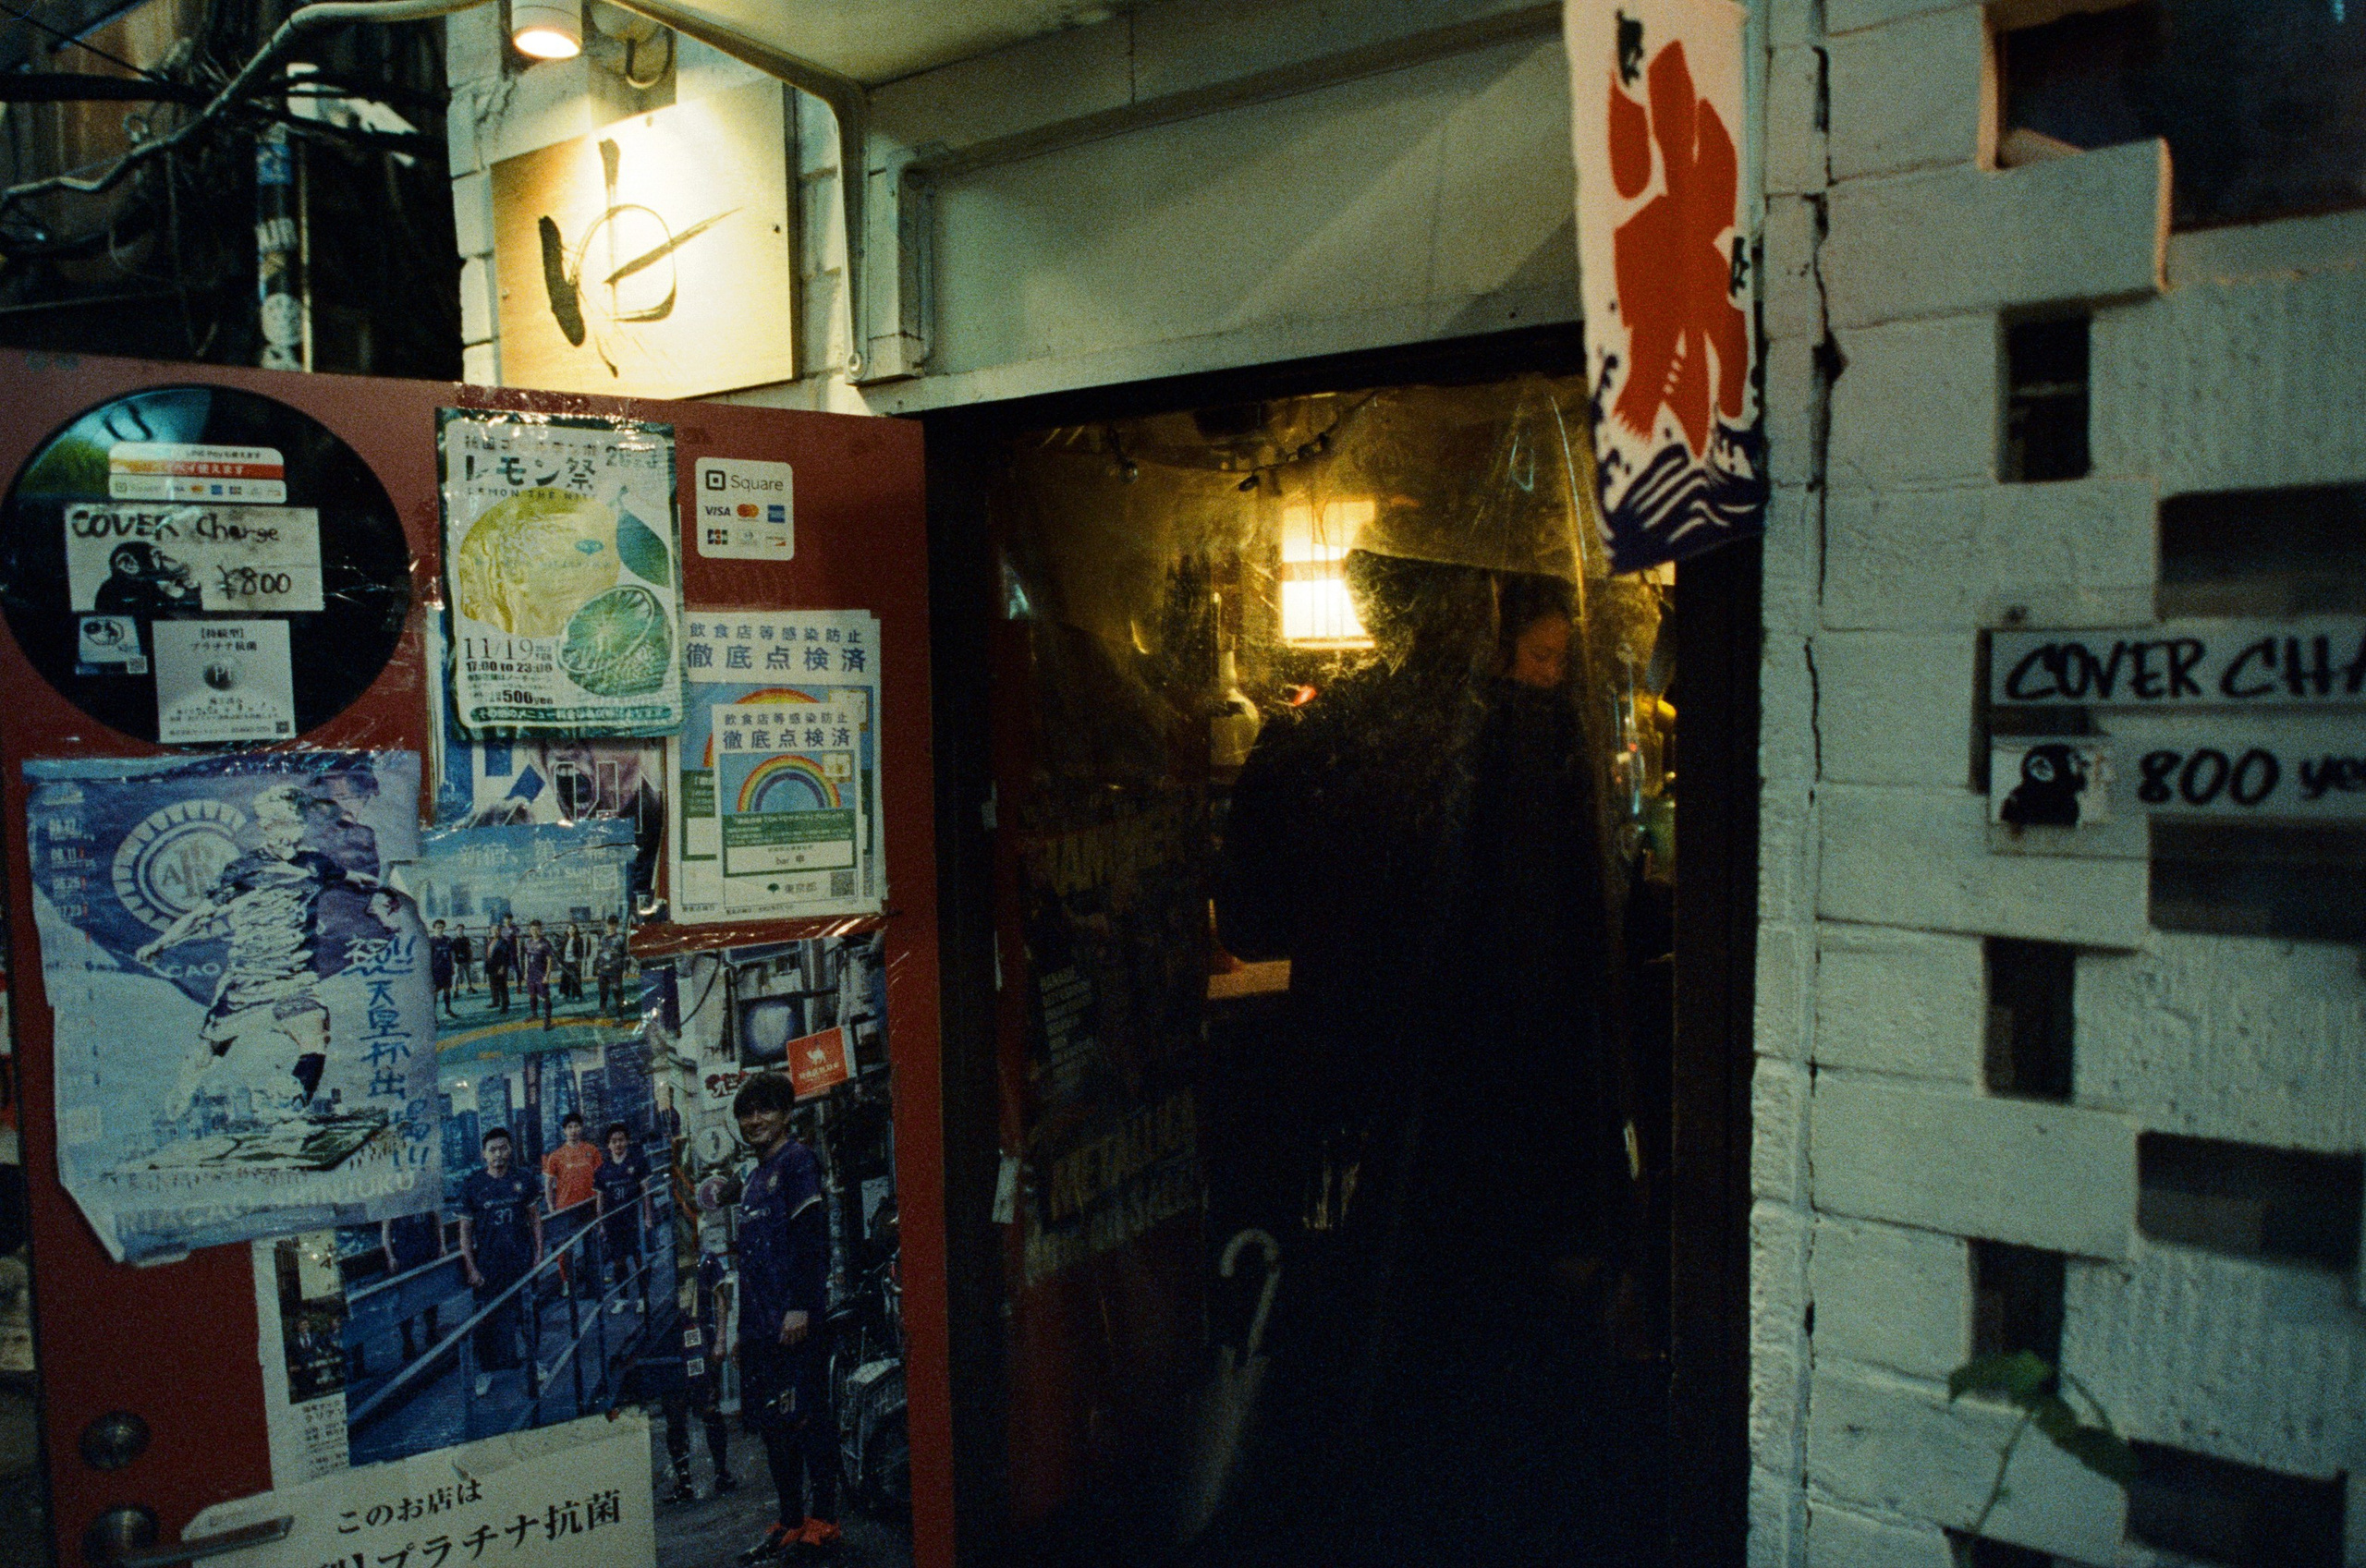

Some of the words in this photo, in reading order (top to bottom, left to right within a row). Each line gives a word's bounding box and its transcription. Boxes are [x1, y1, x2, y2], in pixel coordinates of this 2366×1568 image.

[465, 455, 596, 491] レモン祭
[730, 474, 785, 494] Square
[704, 506, 732, 517] VISA
[71, 509, 179, 541] COVER
[689, 621, 863, 644] 飲食店等感染防止
[463, 638, 534, 661] 11/19
[686, 643, 867, 674] 徹底点検済
[500, 662, 514, 672] to
[2005, 638, 2206, 699] COVER
[725, 711, 848, 727] 飲食店等感染防止
[722, 726, 853, 750] 徹底点検済
[2138, 747, 2280, 807] 800
[337, 1479, 483, 1536] このお店は
